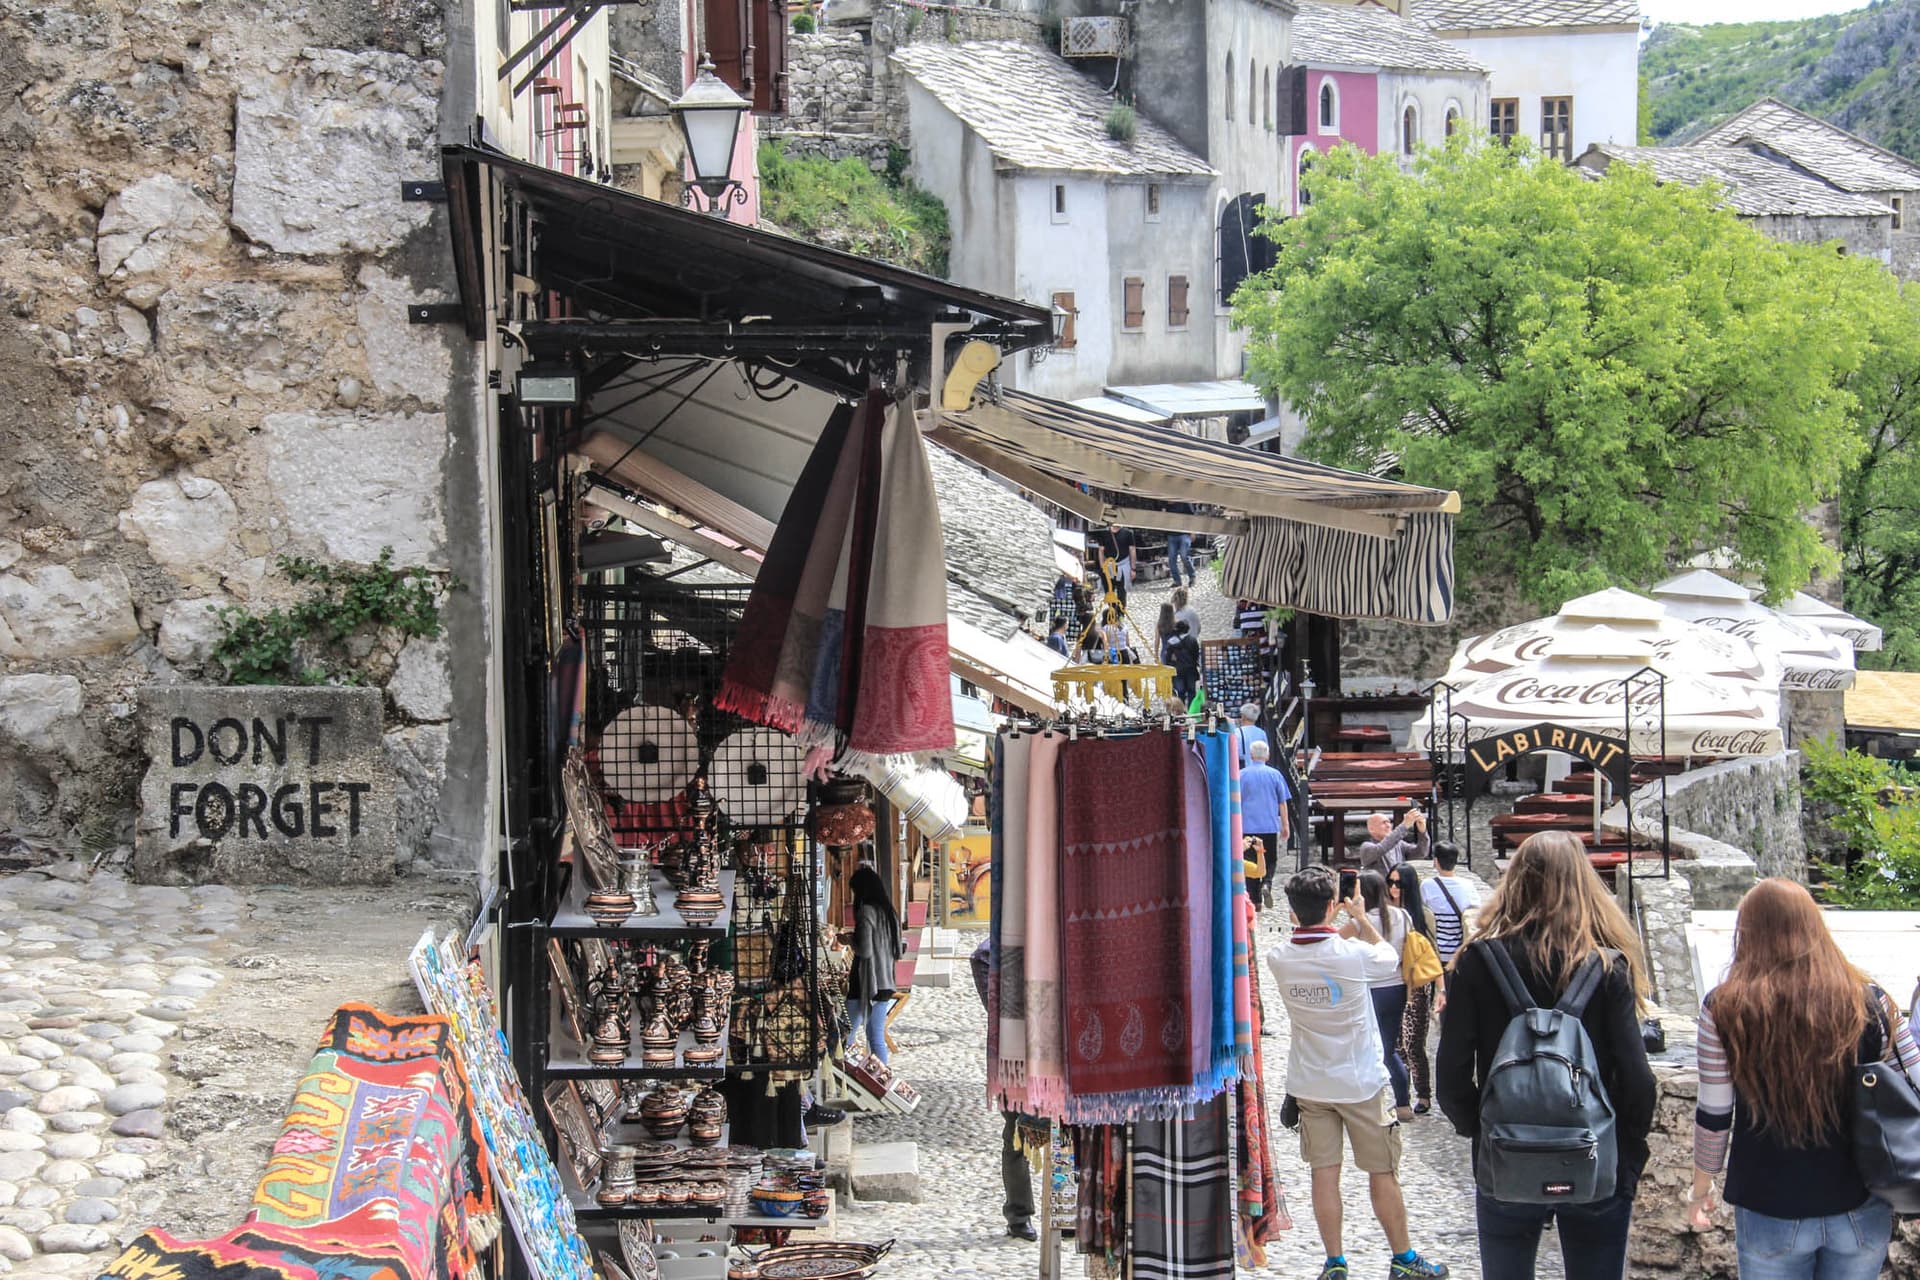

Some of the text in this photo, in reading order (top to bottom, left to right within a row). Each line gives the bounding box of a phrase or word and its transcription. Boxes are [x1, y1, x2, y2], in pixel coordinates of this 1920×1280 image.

[170, 711, 333, 768] DON'T
[1470, 728, 1624, 773] LABIRINT
[1692, 729, 1771, 755] Coca-Cola
[168, 780, 371, 841] FORGET
[1289, 984, 1330, 998] devim
